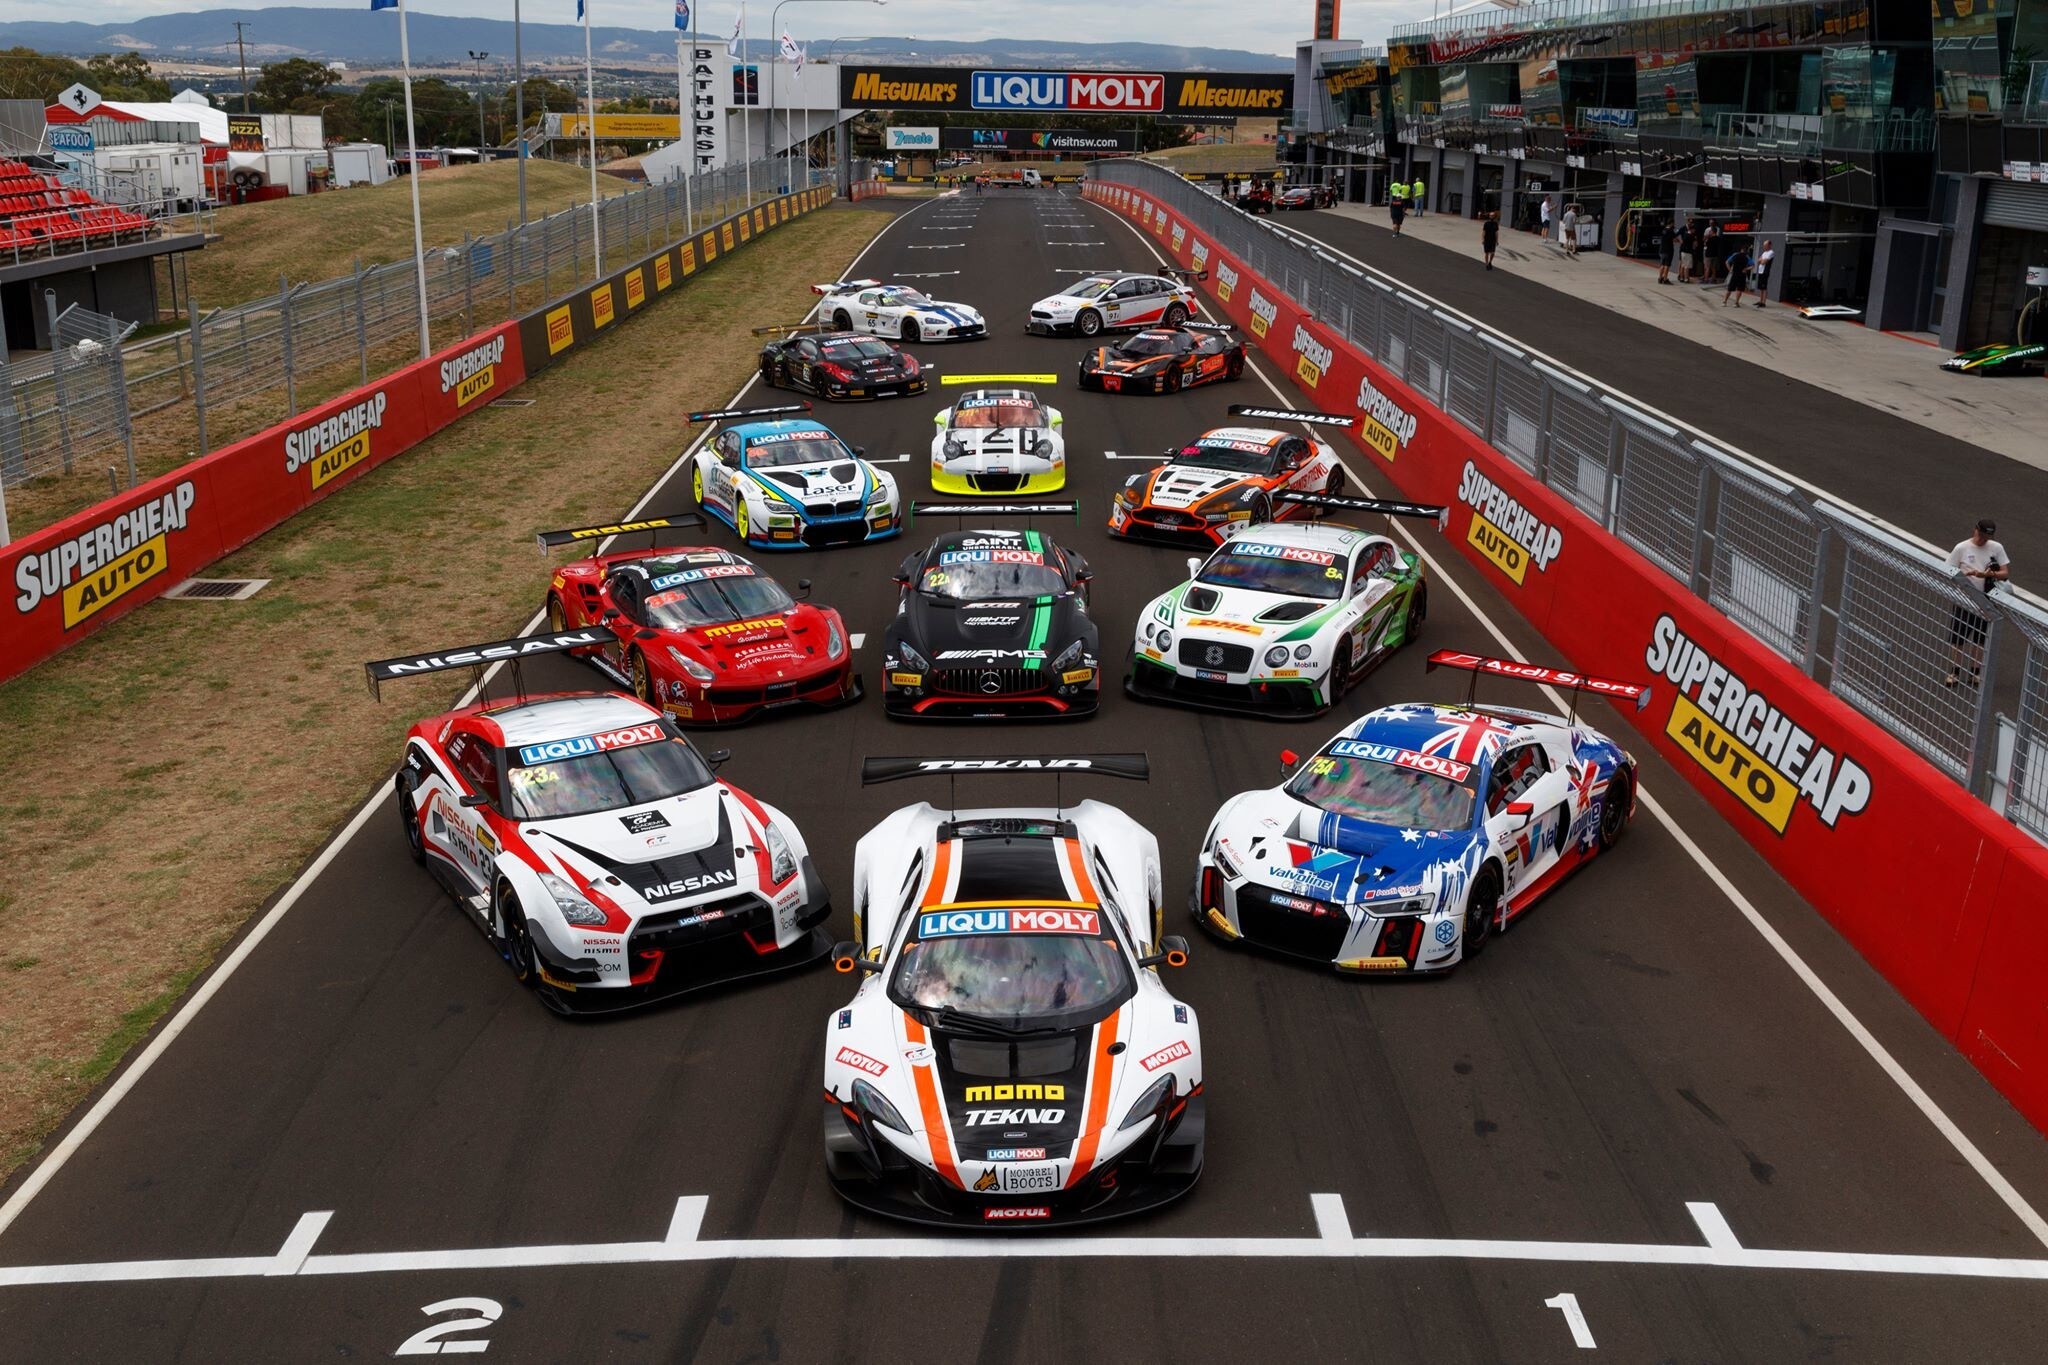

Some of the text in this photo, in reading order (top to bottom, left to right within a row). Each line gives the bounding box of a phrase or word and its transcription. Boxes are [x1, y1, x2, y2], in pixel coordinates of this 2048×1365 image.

[852, 73, 957, 102] MEGUIAR'S
[977, 75, 1161, 108] LIQUI MOLY
[1178, 79, 1284, 108] MEGUIAR'S
[695, 49, 715, 165] BATHURST
[49, 132, 91, 147] SEAFOOD
[229, 125, 262, 136] PIZZA
[972, 130, 1008, 144] NSW
[1052, 131, 1118, 148] visitnsw.com
[1629, 200, 1651, 208] M-SPORT
[1723, 223, 1750, 232] M-SPORT
[593, 293, 612, 319] PIRELLI
[549, 314, 571, 345] PIRELLI
[867, 318, 876, 328] 65
[823, 338, 850, 347] LIQUI
[1292, 324, 1333, 376] SUPERCHEAP
[440, 334, 505, 393] SUPERCHEAP
[461, 371, 491, 400] AUTO
[966, 400, 997, 408] LIQUI
[1355, 376, 1417, 449] SUPERCHEAP
[285, 391, 387, 474] SUPERCHEAP
[754, 431, 826, 446] LIQUI MOLY
[1366, 424, 1393, 453] AUTO
[1199, 438, 1270, 455] LIQUI MOLY
[319, 439, 363, 480] AUTO
[802, 483, 857, 497] Laser
[1230, 512, 1250, 520] PIRELLI
[1457, 459, 1563, 573] SUPERCHEAP
[570, 519, 672, 539] momo
[16, 481, 195, 613] SUPERCHEAP
[962, 538, 1023, 547] SAINT
[1474, 517, 1521, 570] AUTO
[943, 551, 1043, 566] LIQUI MOLY
[1235, 544, 1333, 566] LIQUI MOLY
[78, 548, 156, 613] AUTO
[653, 565, 751, 590] LIQUI MOLY
[1325, 567, 1343, 581] 8A
[704, 618, 786, 638] momo
[1197, 619, 1251, 633] DHL
[387, 632, 597, 674] NISSAN
[736, 662, 747, 671] My
[772, 652, 807, 660] Australia
[971, 650, 1048, 659] AMG
[885, 659, 899, 668] SAINT
[894, 675, 918, 684] PIRELLI
[1065, 671, 1090, 682] PIRELLI
[1197, 671, 1227, 681] LIQUI MOLY
[1273, 670, 1298, 678] PIRELLI
[1487, 660, 1640, 695] Audi Sport
[1645, 612, 1872, 831] SUPERCHEAP
[524, 724, 662, 764] LIQUI MOLY
[918, 759, 1092, 771] TEKNO
[1307, 758, 1335, 776] 75A
[1334, 740, 1469, 782] LIQUI MOLY
[1681, 716, 1776, 804] AUTO
[519, 767, 560, 786] 23A
[437, 796, 475, 848] NISSAN
[626, 811, 653, 820] NISSAN
[630, 820, 664, 830] ACADEMY
[633, 815, 652, 825] GT
[447, 826, 478, 867] ismo
[643, 868, 736, 900] NISSAN
[1269, 865, 1333, 891] Valvoline
[776, 889, 799, 907] NISSAN
[1375, 884, 1425, 898] Audi Sport
[779, 898, 801, 915] nismo
[1271, 895, 1313, 913] LIQUI MOLY
[680, 910, 724, 926] LIQUI MOLY
[924, 911, 1097, 935] LIQUI MOLY
[1210, 911, 1229, 931] PIRELLI
[583, 938, 620, 946] NISSAN
[1358, 959, 1400, 969] PIRELLI
[837, 1048, 885, 1076] MOTUL
[1144, 1042, 1189, 1070] MOTUL
[965, 1084, 1065, 1103] momo
[964, 1108, 1066, 1127] TEKNO
[988, 1149, 1045, 1160] LIQUI MOLY
[1010, 1168, 1053, 1178] MONGREL
[1010, 1177, 1053, 1190] BOOTS
[988, 1208, 1047, 1218] MOTUL
[395, 1296, 504, 1356] 2
[1543, 1292, 1598, 1349] 1
